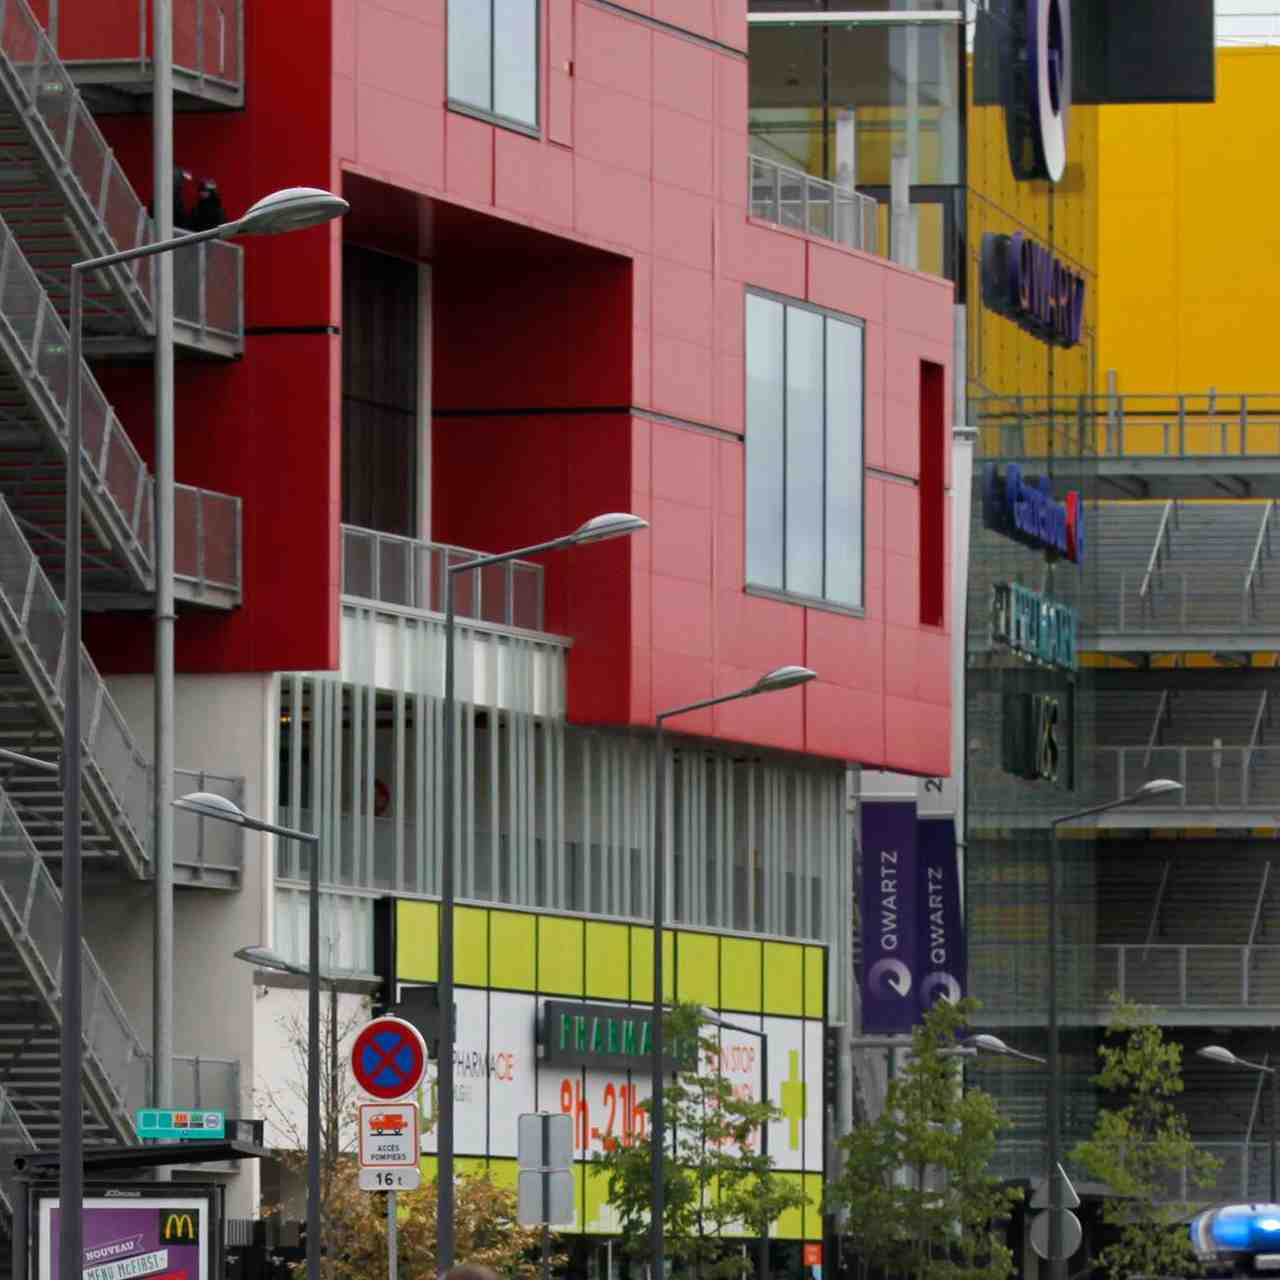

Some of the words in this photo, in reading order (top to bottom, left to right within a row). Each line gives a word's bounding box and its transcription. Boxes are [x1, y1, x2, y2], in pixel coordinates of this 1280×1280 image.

[880, 849, 899, 950] QWARTZ
[926, 866, 947, 964] QWARTZ
[370, 1153, 407, 1161] POMPIERS
[375, 1172, 394, 1186] 16
[397, 1176, 403, 1186] t
[85, 1241, 135, 1262] NOUVEAU
